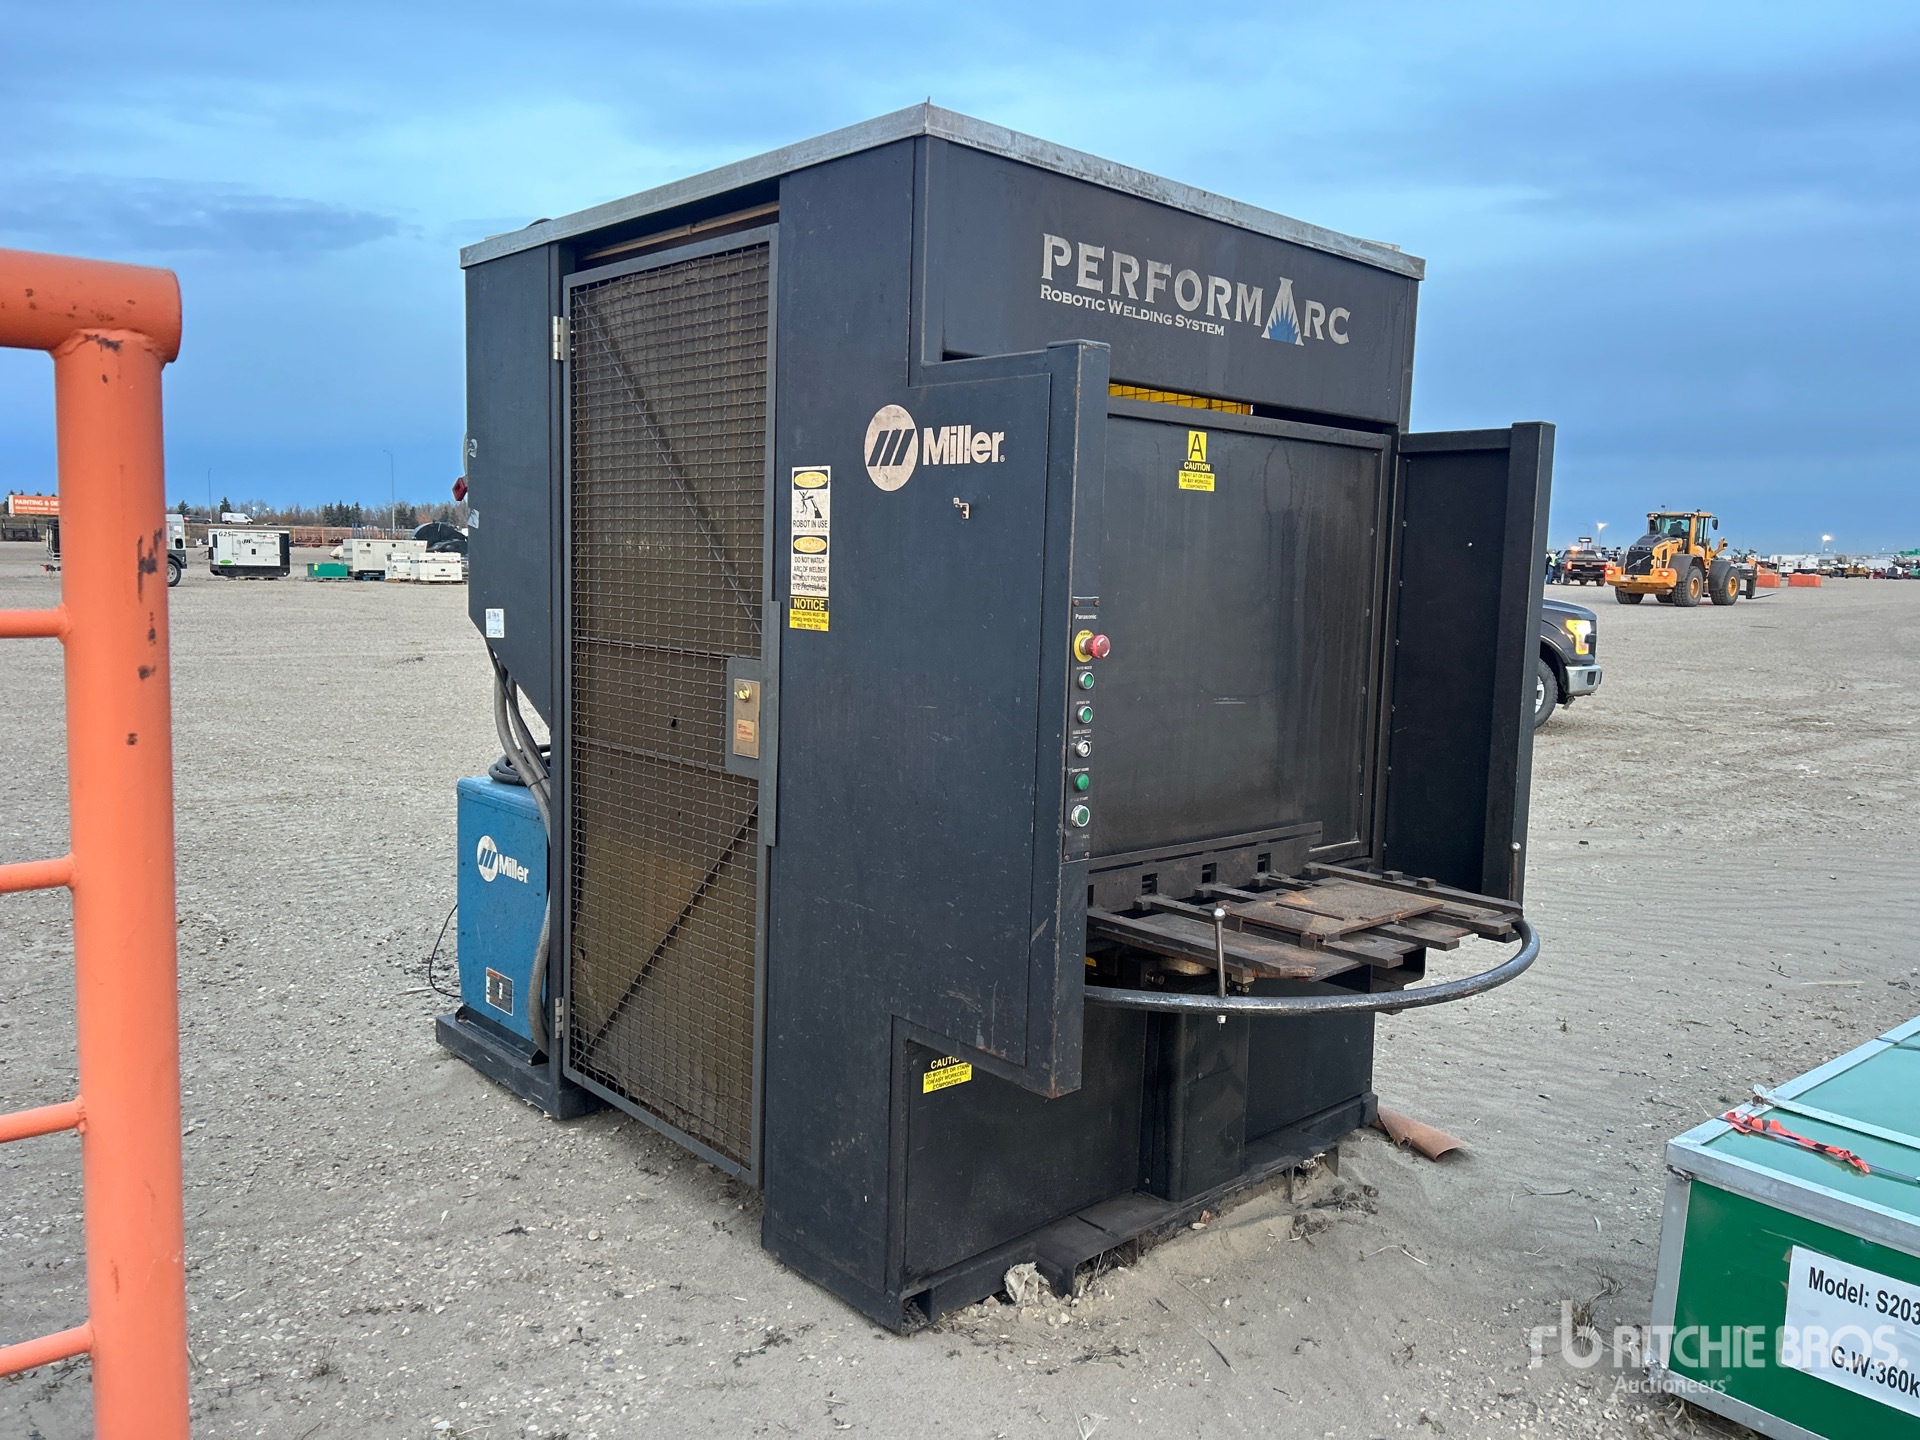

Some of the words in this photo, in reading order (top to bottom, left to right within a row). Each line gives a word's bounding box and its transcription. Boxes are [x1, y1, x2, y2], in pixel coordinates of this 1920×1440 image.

[1041, 233, 1352, 346] PERFORMARC
[923, 425, 1005, 466] Miller
[1189, 433, 1204, 460] A
[1184, 461, 1211, 472] CAUTION
[793, 519, 810, 528] ROBOT
[811, 520, 817, 528] IN
[817, 520, 828, 528] USE
[801, 556, 809, 564] NOT
[810, 556, 825, 564] WATCH
[793, 565, 802, 573] ARC
[809, 566, 826, 574] WELDER
[811, 575, 827, 583] PROPER
[793, 598, 825, 611] NOTICE
[498, 854, 529, 884] Miller
[930, 1056, 960, 1070] CAUTI
[1808, 1266, 1869, 1308] Model:
